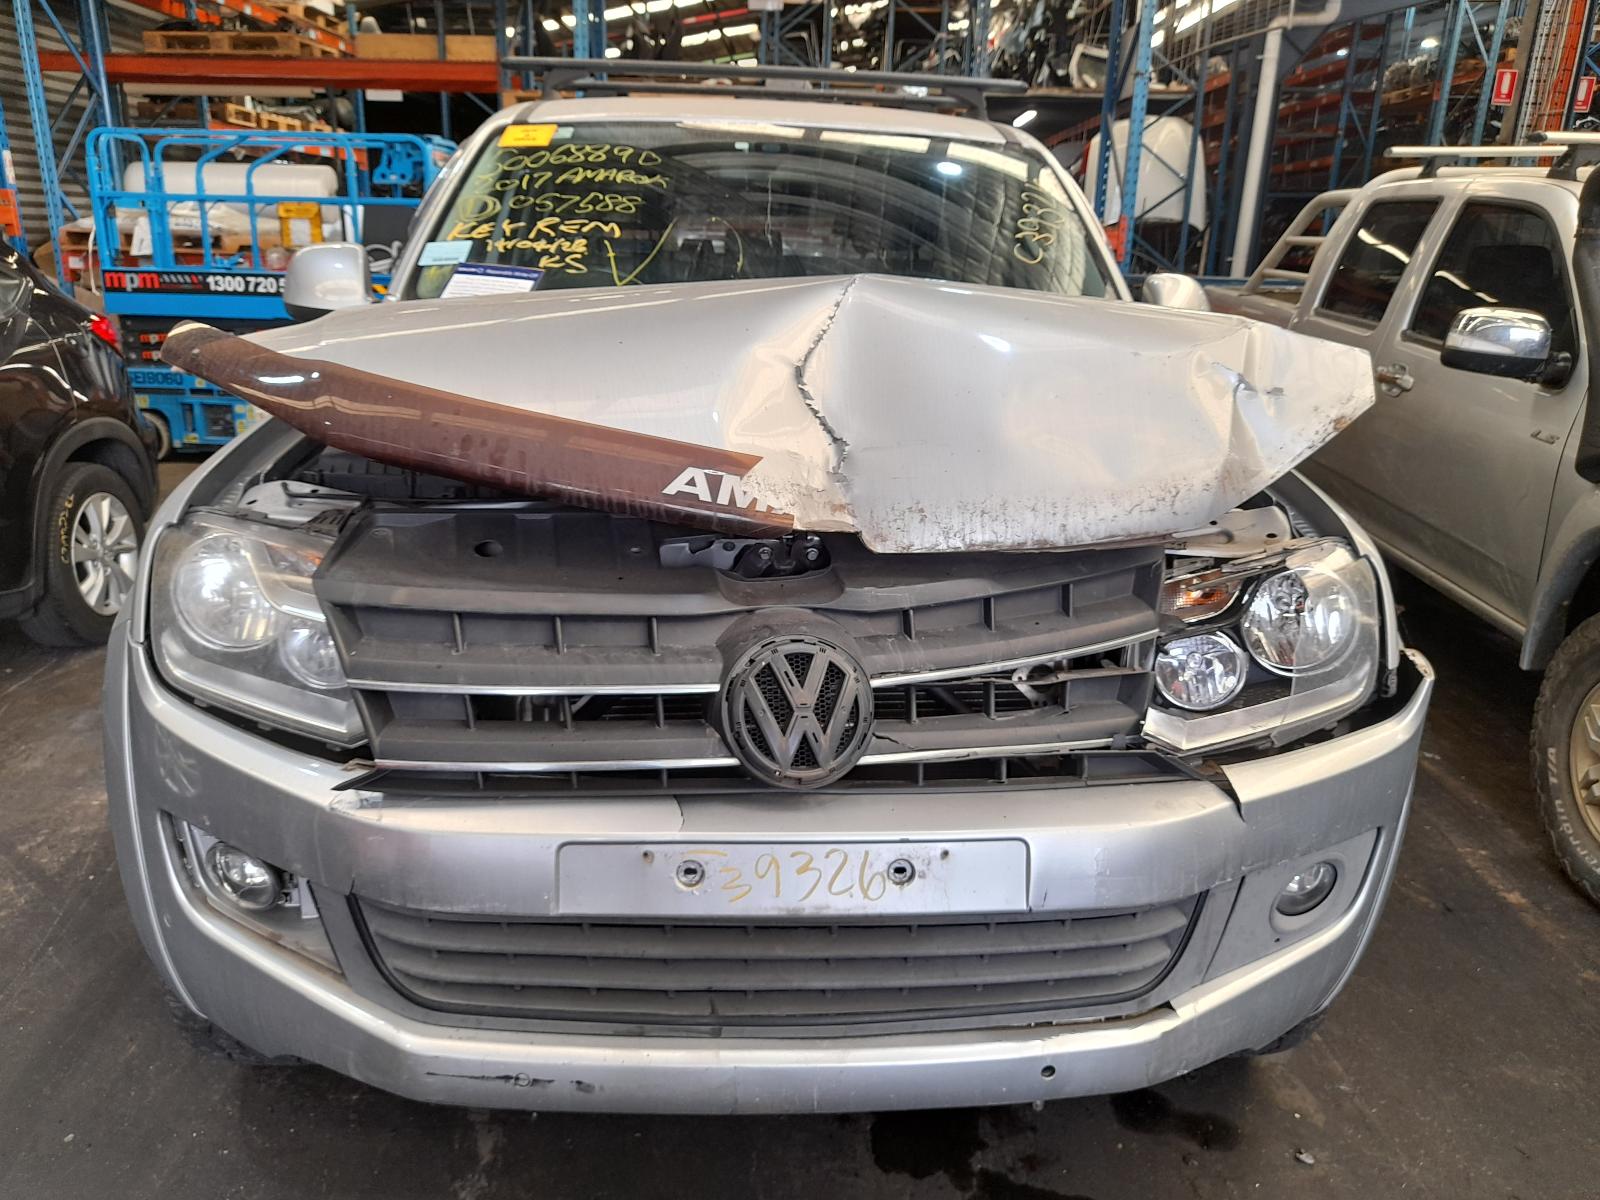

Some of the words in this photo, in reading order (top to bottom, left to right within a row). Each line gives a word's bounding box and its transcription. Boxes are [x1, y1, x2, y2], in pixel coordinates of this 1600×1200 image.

[104, 272, 160, 291] mpm
[206, 275, 246, 292] 1300
[247, 277, 278, 293] 720
